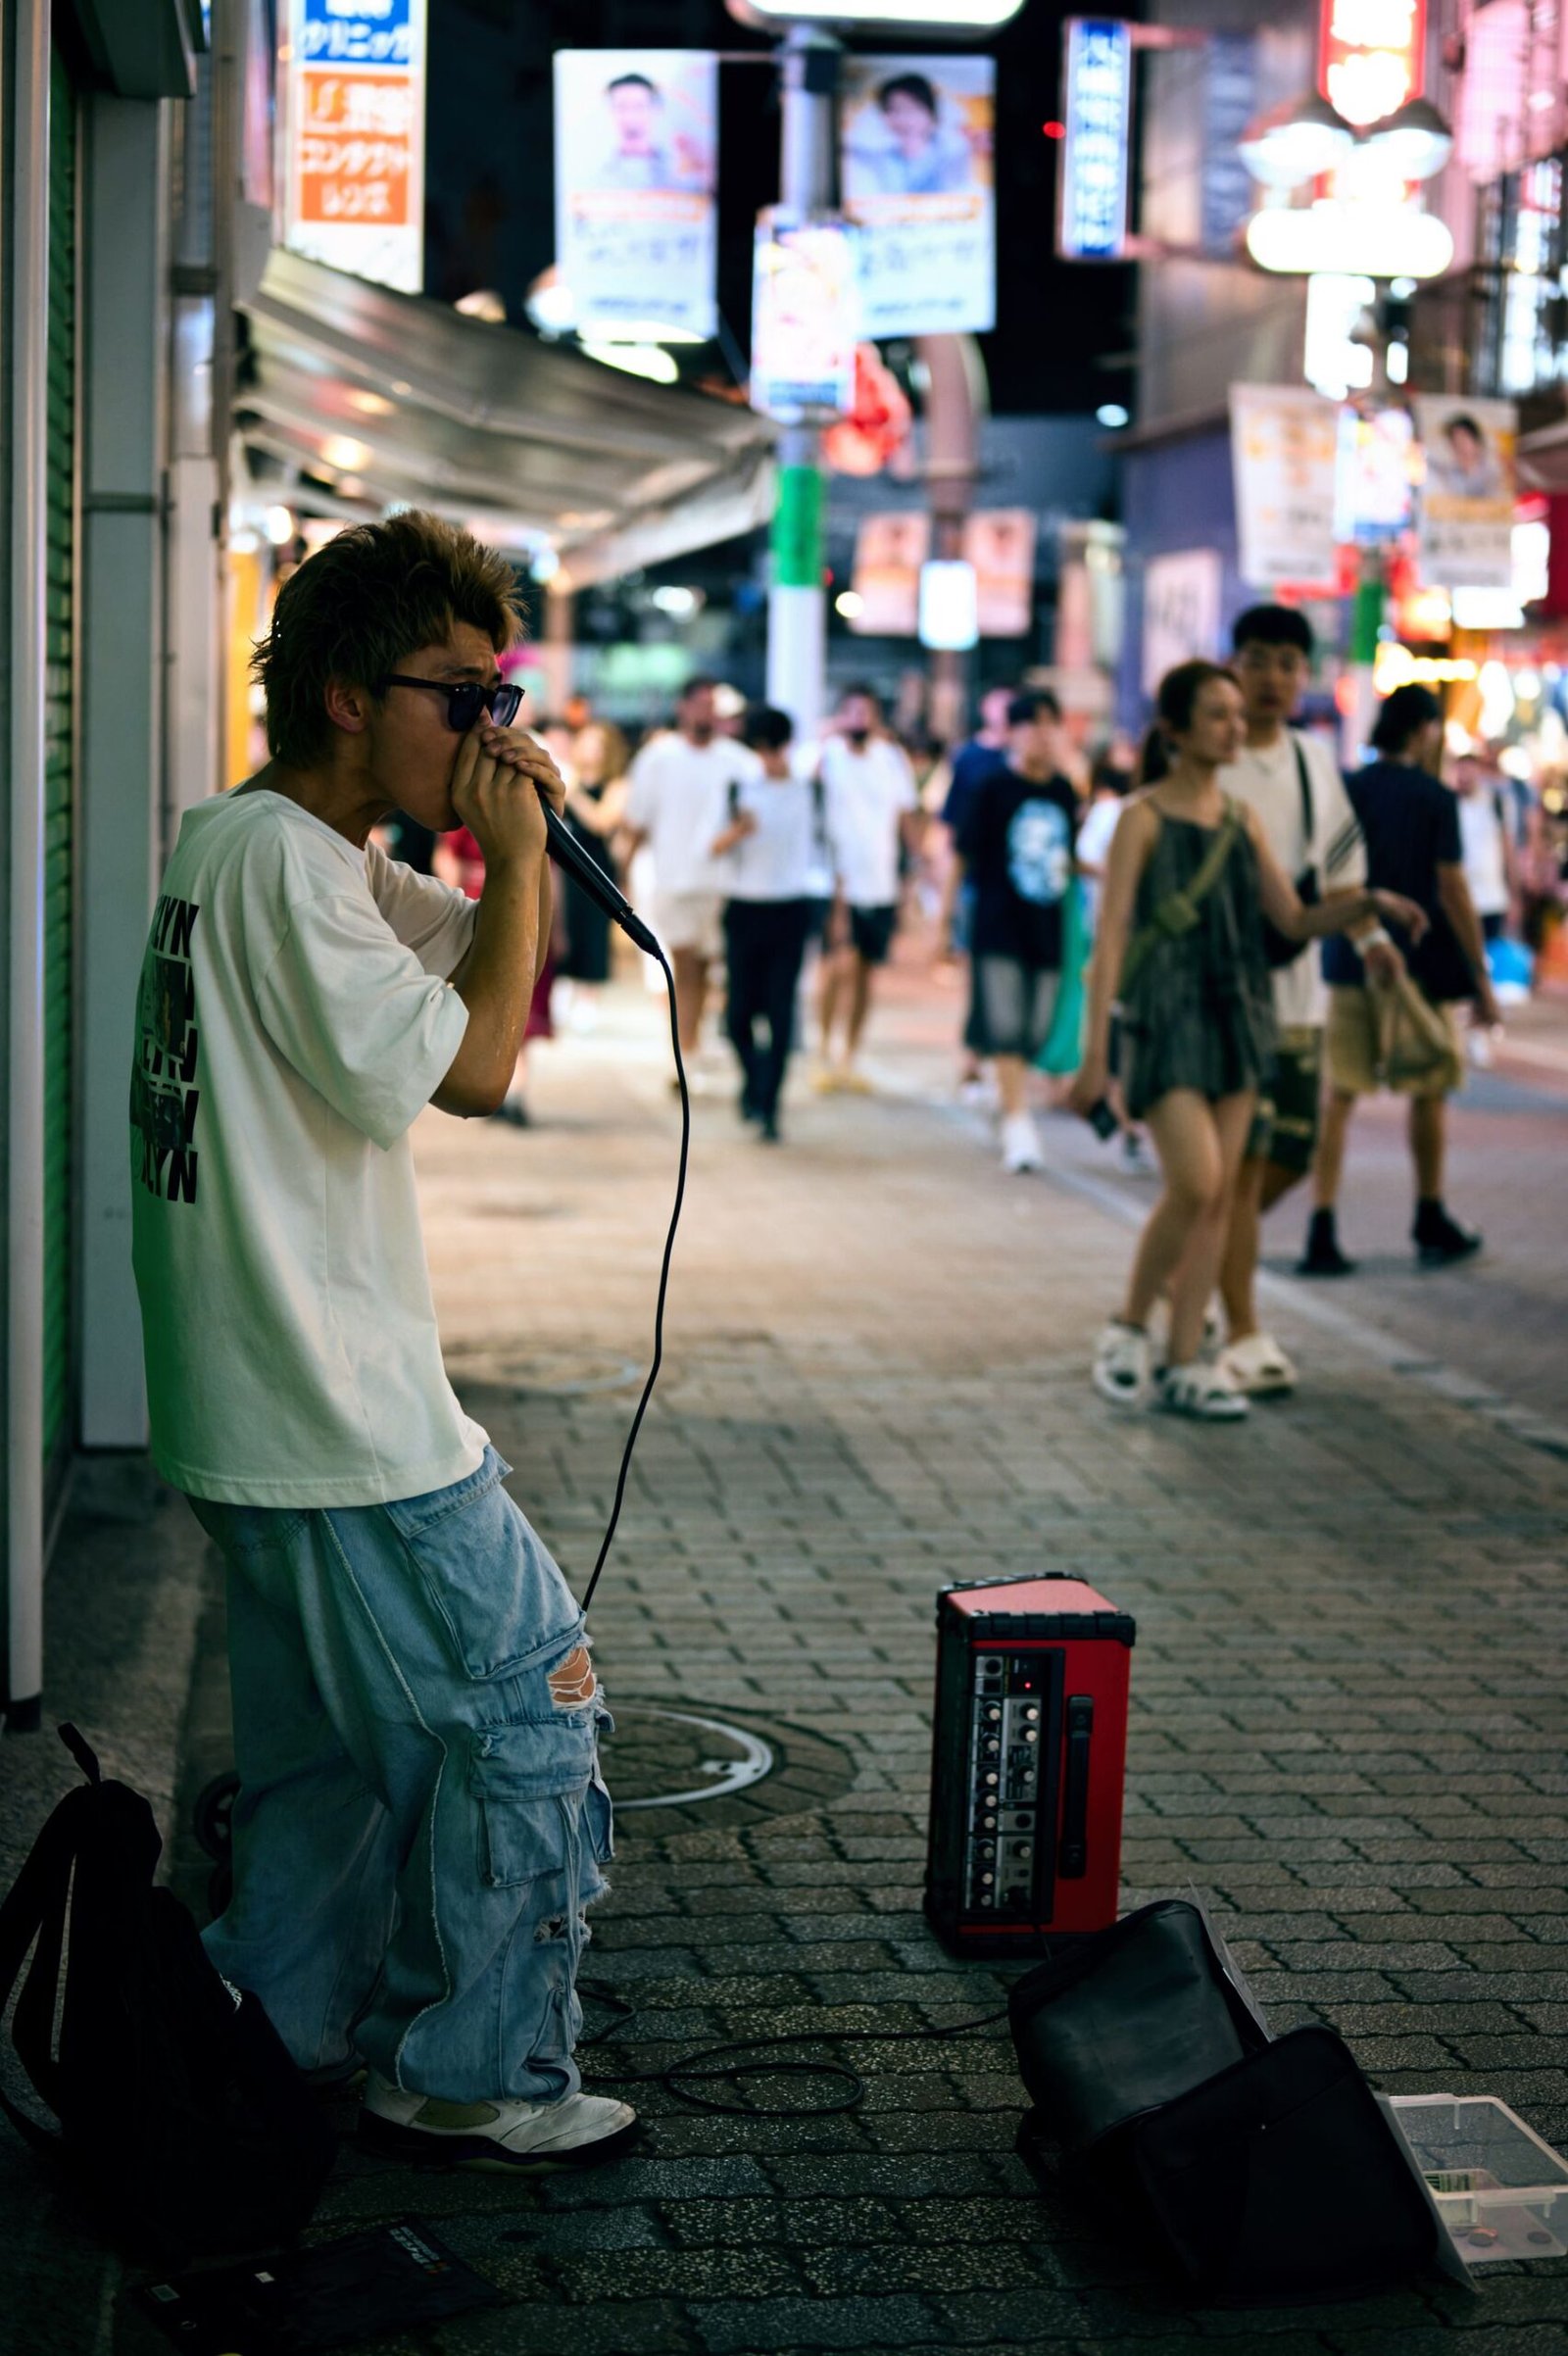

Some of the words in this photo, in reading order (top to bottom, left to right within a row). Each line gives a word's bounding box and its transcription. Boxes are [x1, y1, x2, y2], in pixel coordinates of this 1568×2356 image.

[298, 19, 413, 61] クリニック
